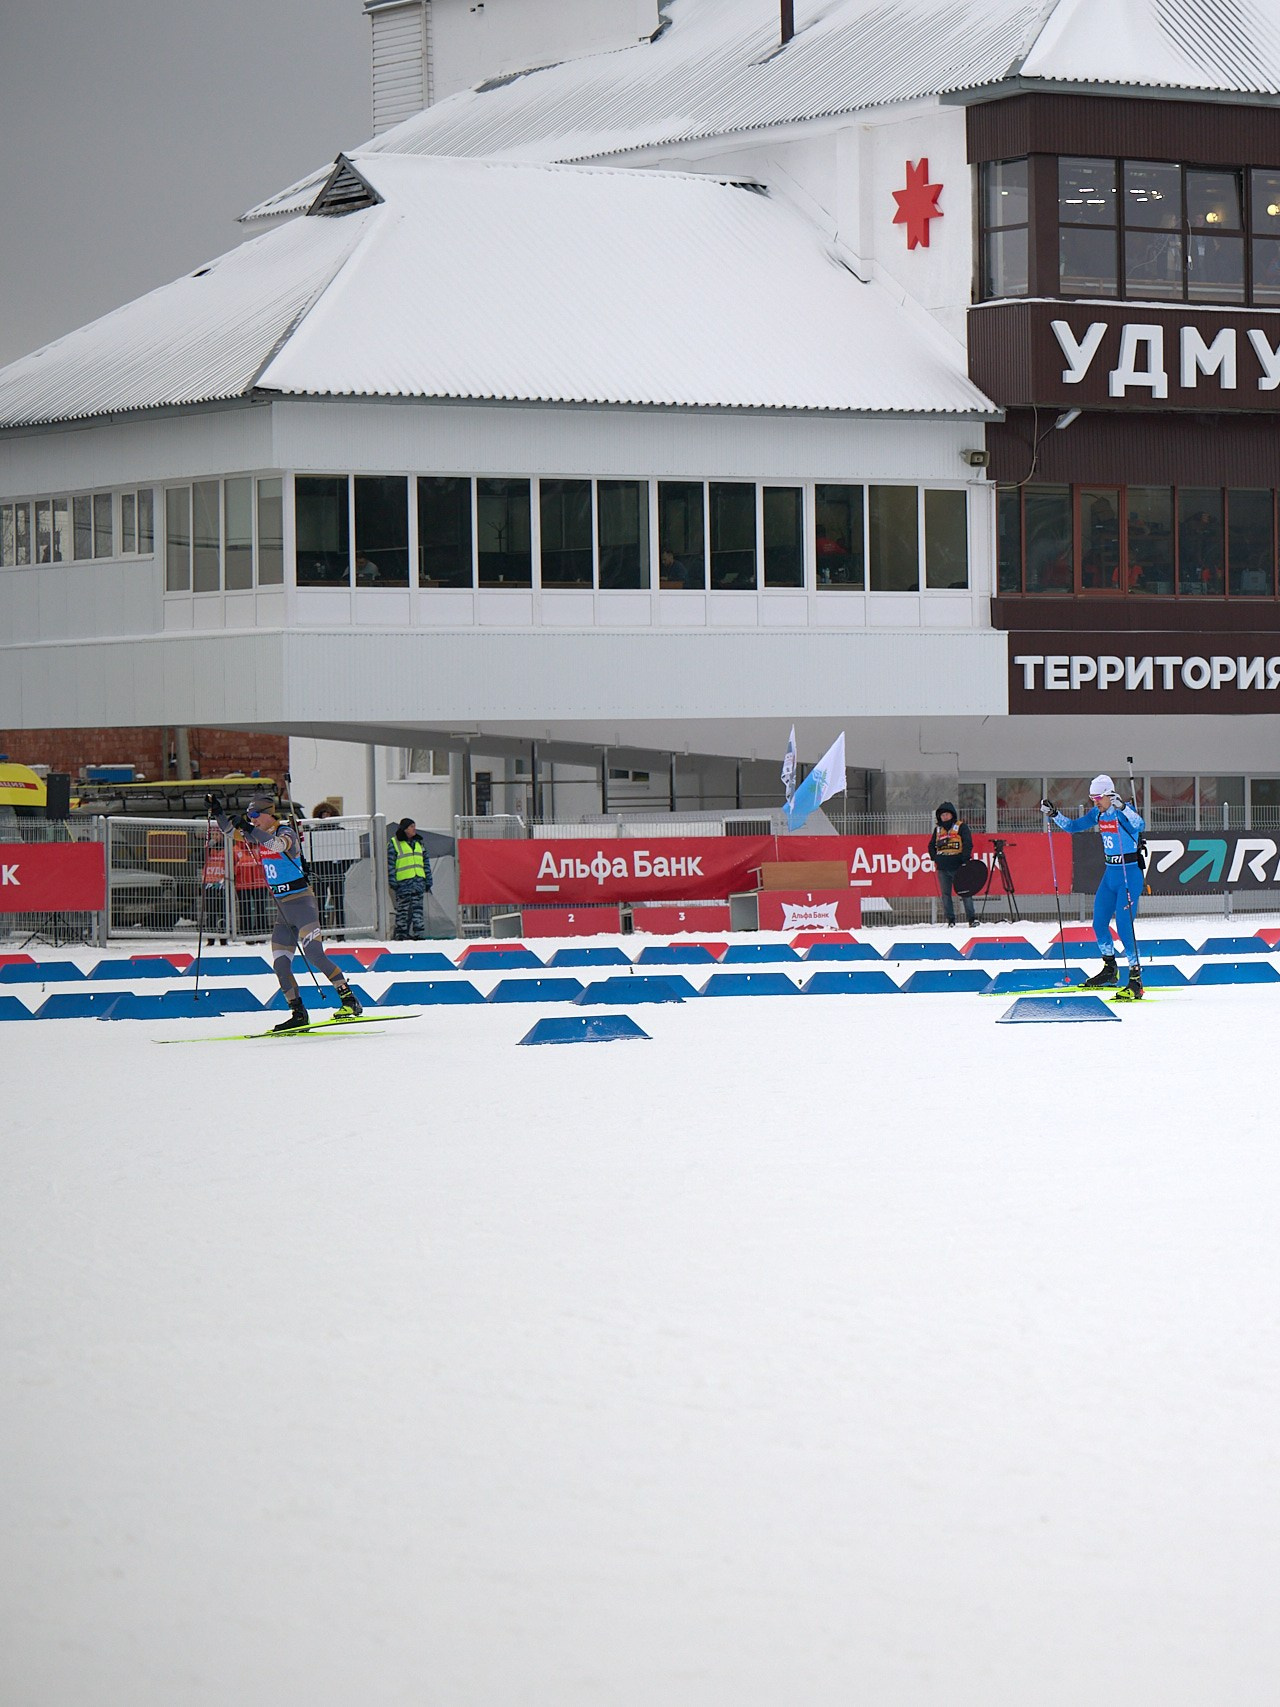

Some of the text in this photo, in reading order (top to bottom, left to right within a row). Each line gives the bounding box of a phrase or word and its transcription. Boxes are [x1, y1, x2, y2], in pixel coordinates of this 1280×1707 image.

[1103, 835, 1114, 849] 26
[537, 850, 704, 885] Альфа Банк
[850, 846, 936, 880] Альфа
[806, 892, 813, 902] 1
[567, 913, 575, 923] 2
[678, 912, 686, 921] 3
[791, 911, 830, 920] Альфа Банк
